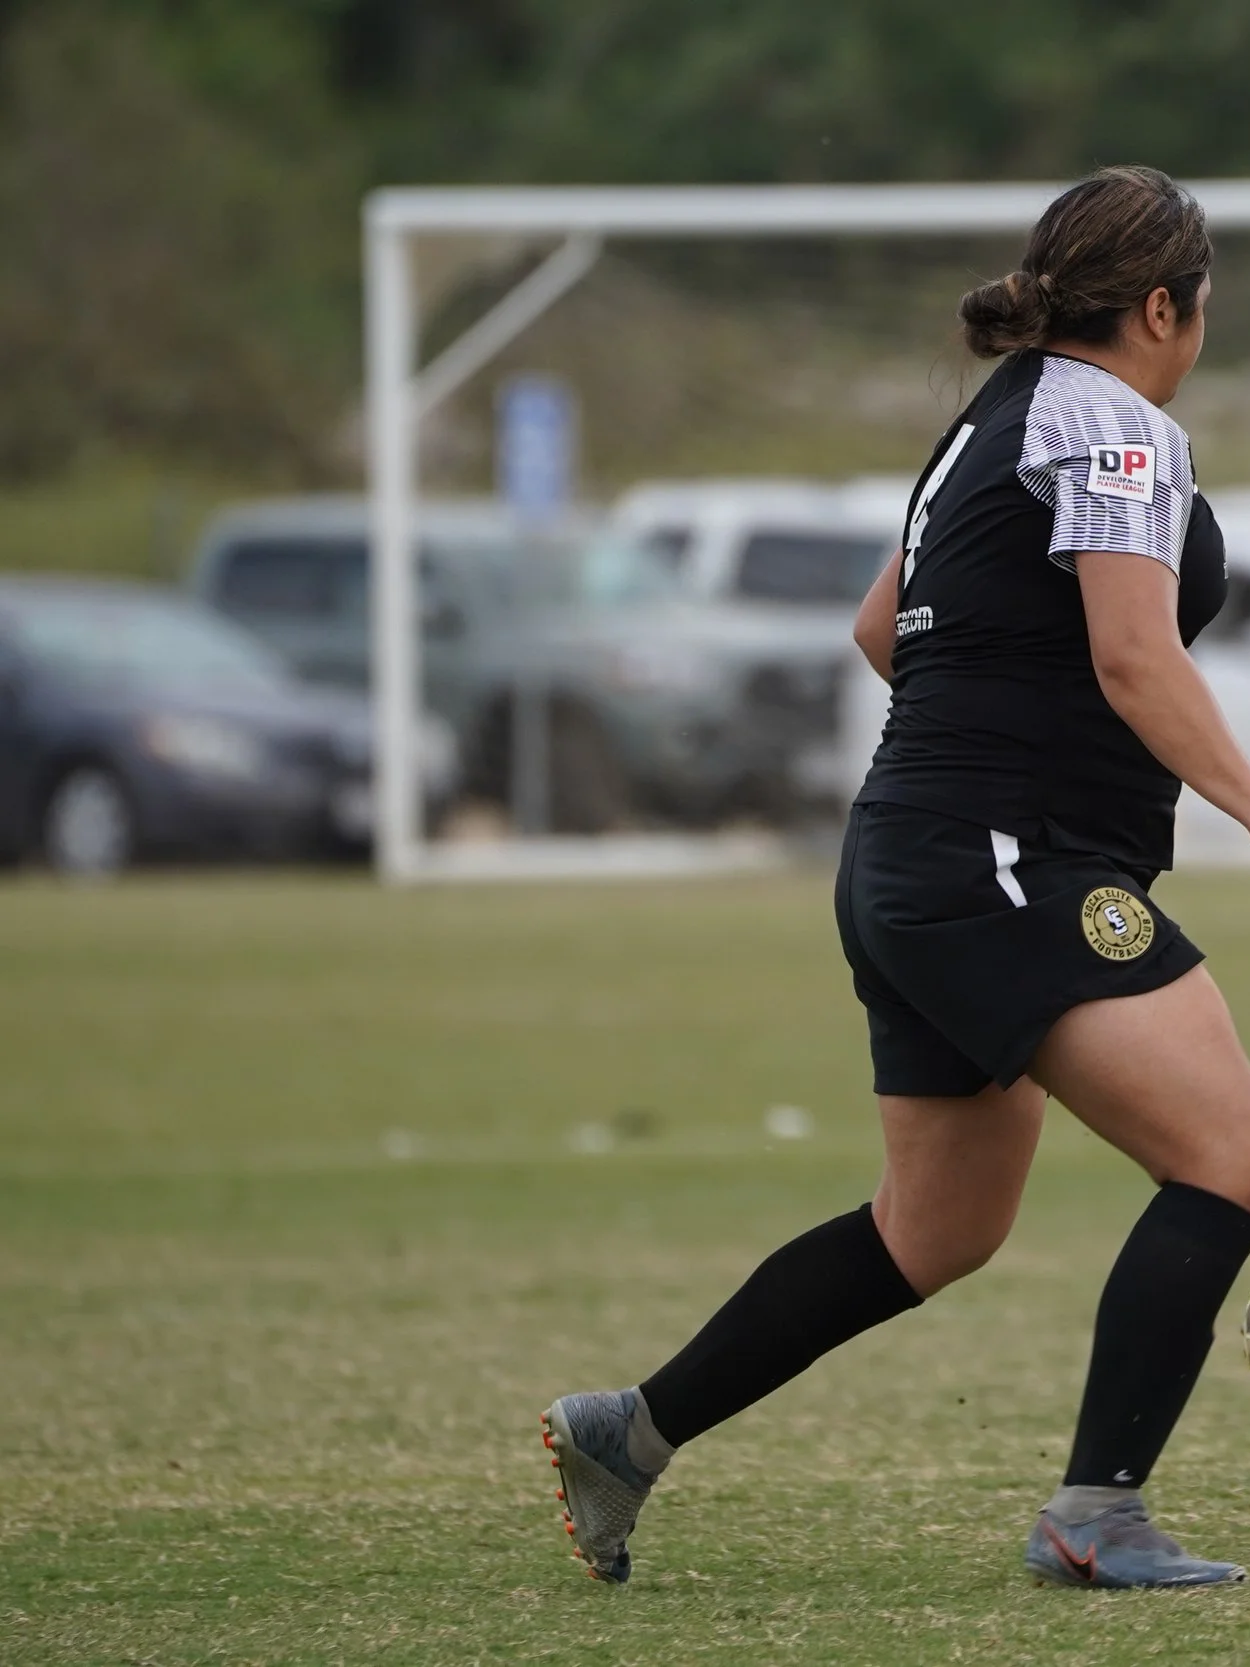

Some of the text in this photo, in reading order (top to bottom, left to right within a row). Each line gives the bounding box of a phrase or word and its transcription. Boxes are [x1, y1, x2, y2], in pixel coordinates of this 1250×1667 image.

[1098, 450, 1147, 476] DP
[1096, 480, 1145, 494] PLAYER LEAGUE
[1097, 474, 1145, 488] DEVELOPMENT
[1084, 889, 1132, 919] SOCAL ELITE
[1092, 918, 1152, 958] FOOTBALL CLUB
